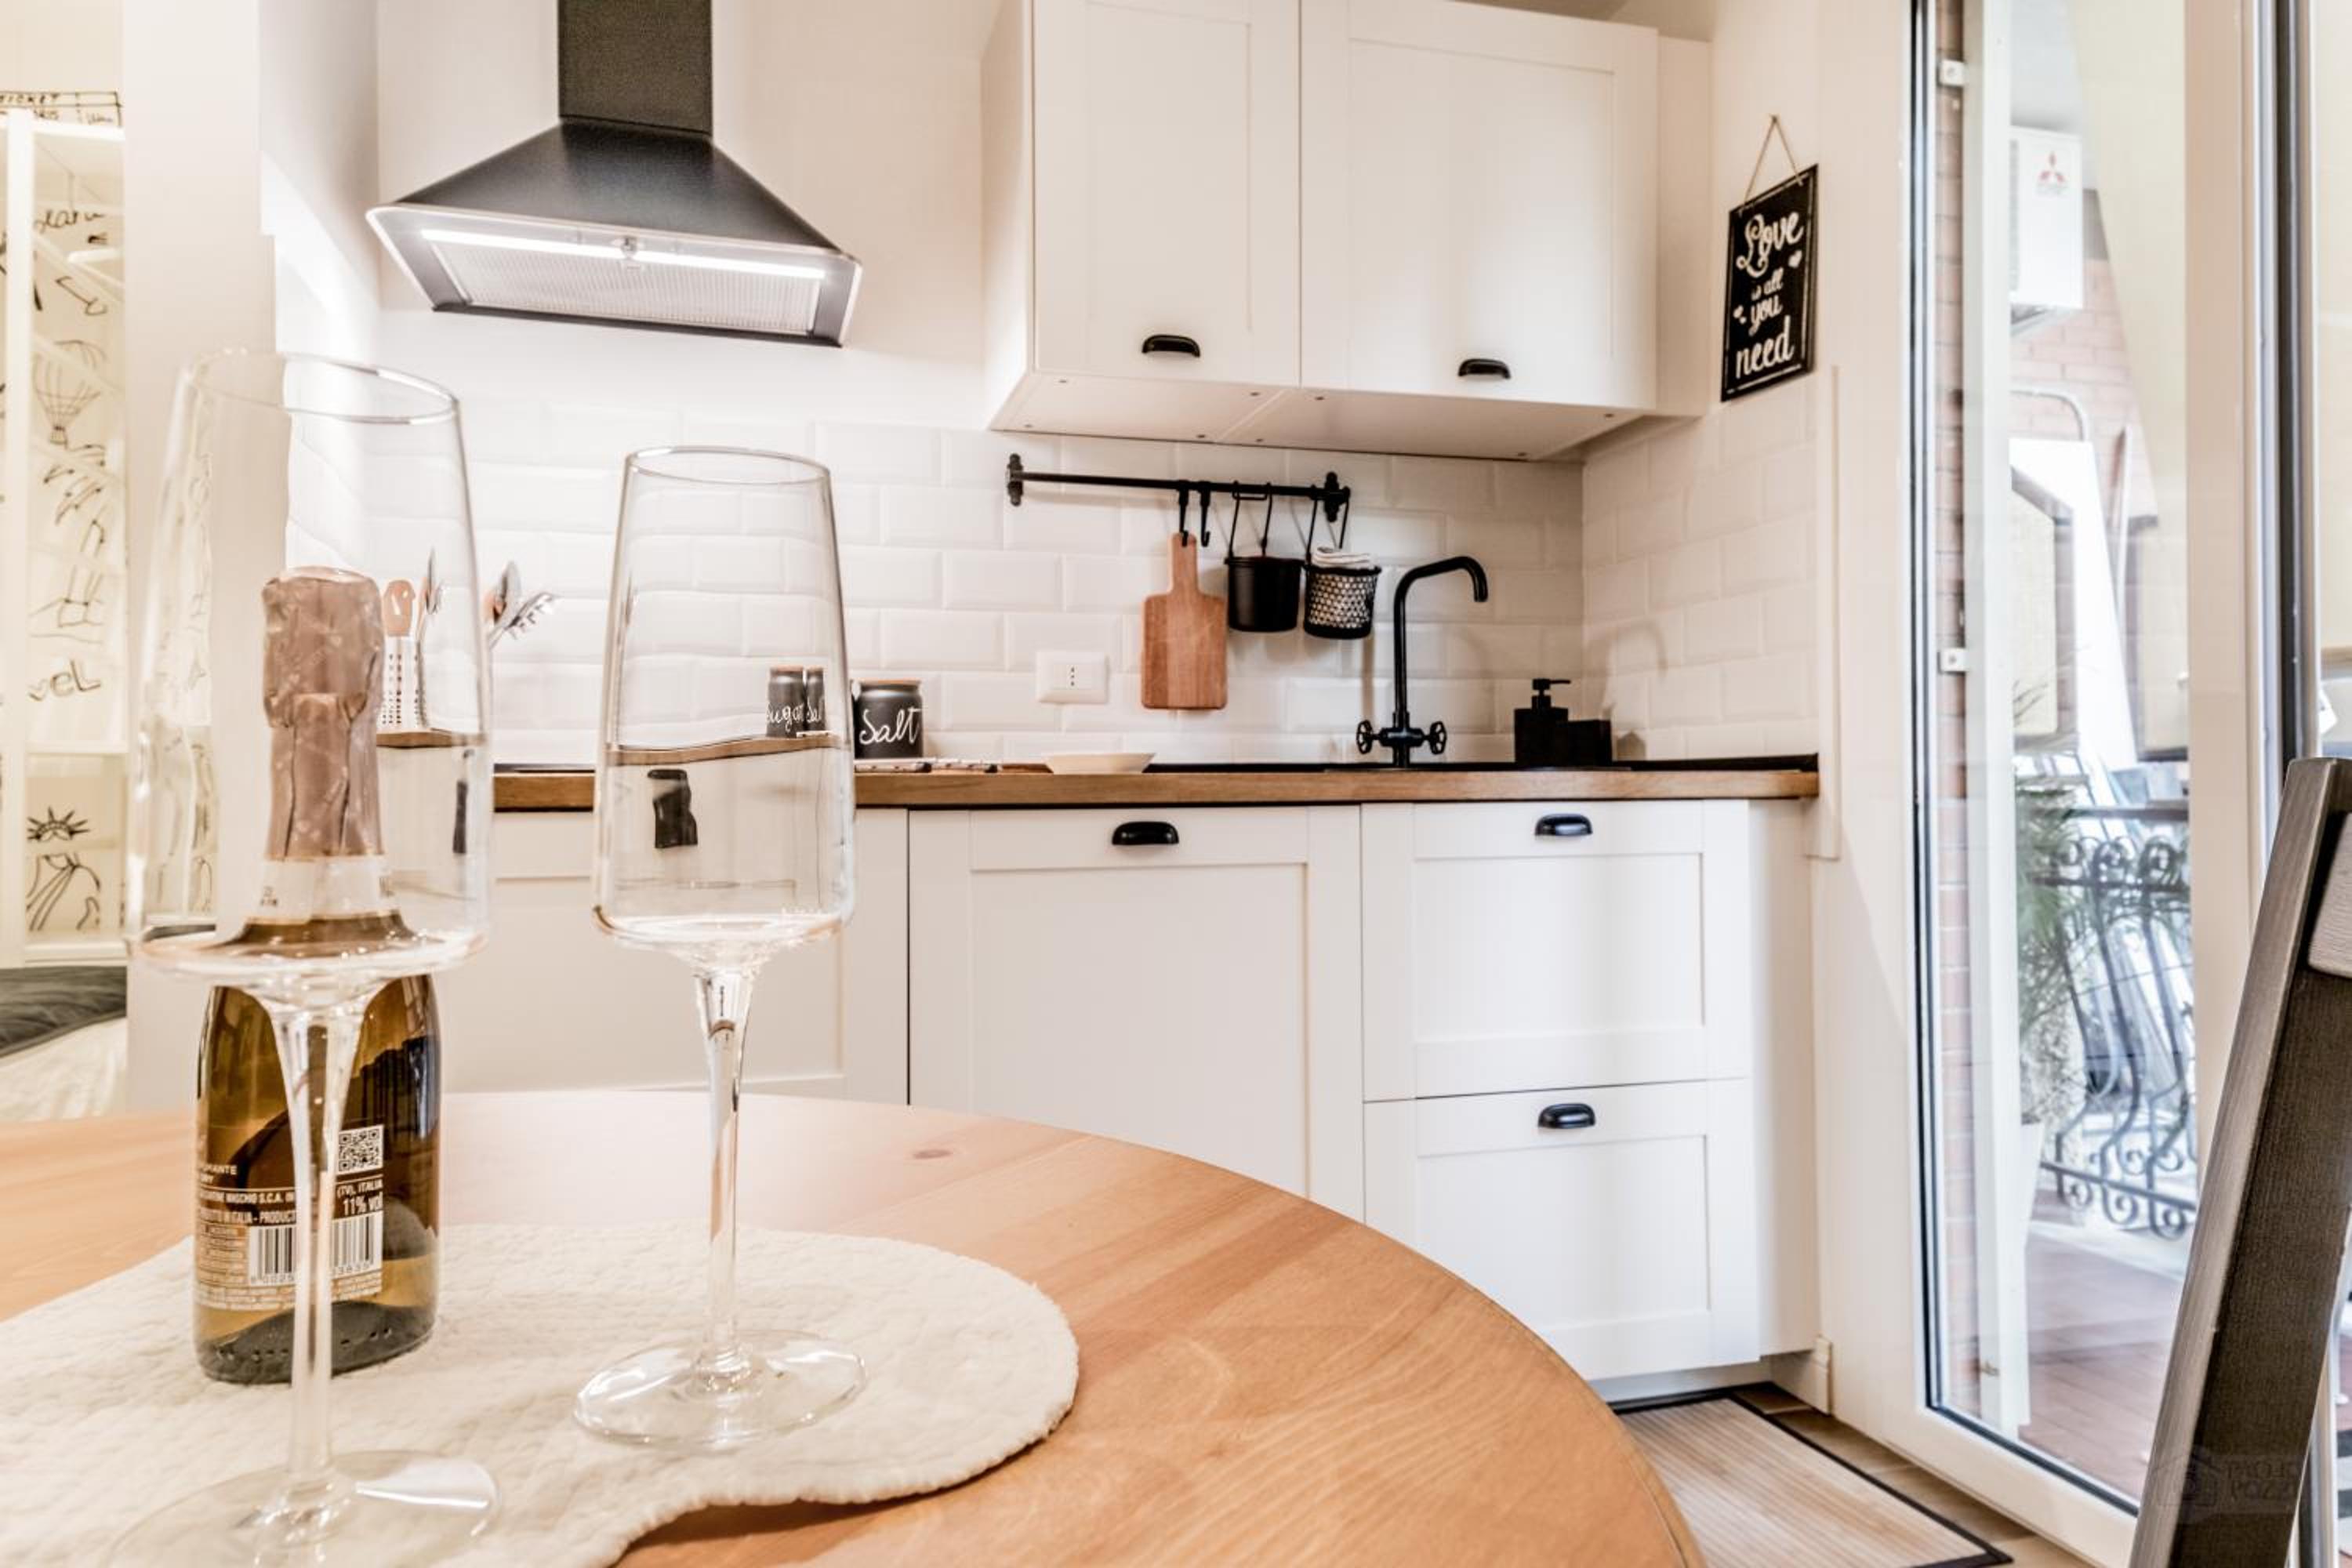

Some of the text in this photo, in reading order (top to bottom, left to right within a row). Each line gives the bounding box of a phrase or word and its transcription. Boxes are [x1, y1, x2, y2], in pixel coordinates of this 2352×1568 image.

[1736, 211, 1804, 278] Love
[1763, 267, 1784, 295] all
[1748, 293, 1783, 337] you
[1735, 314, 1795, 379] need
[859, 706, 922, 745] Salt
